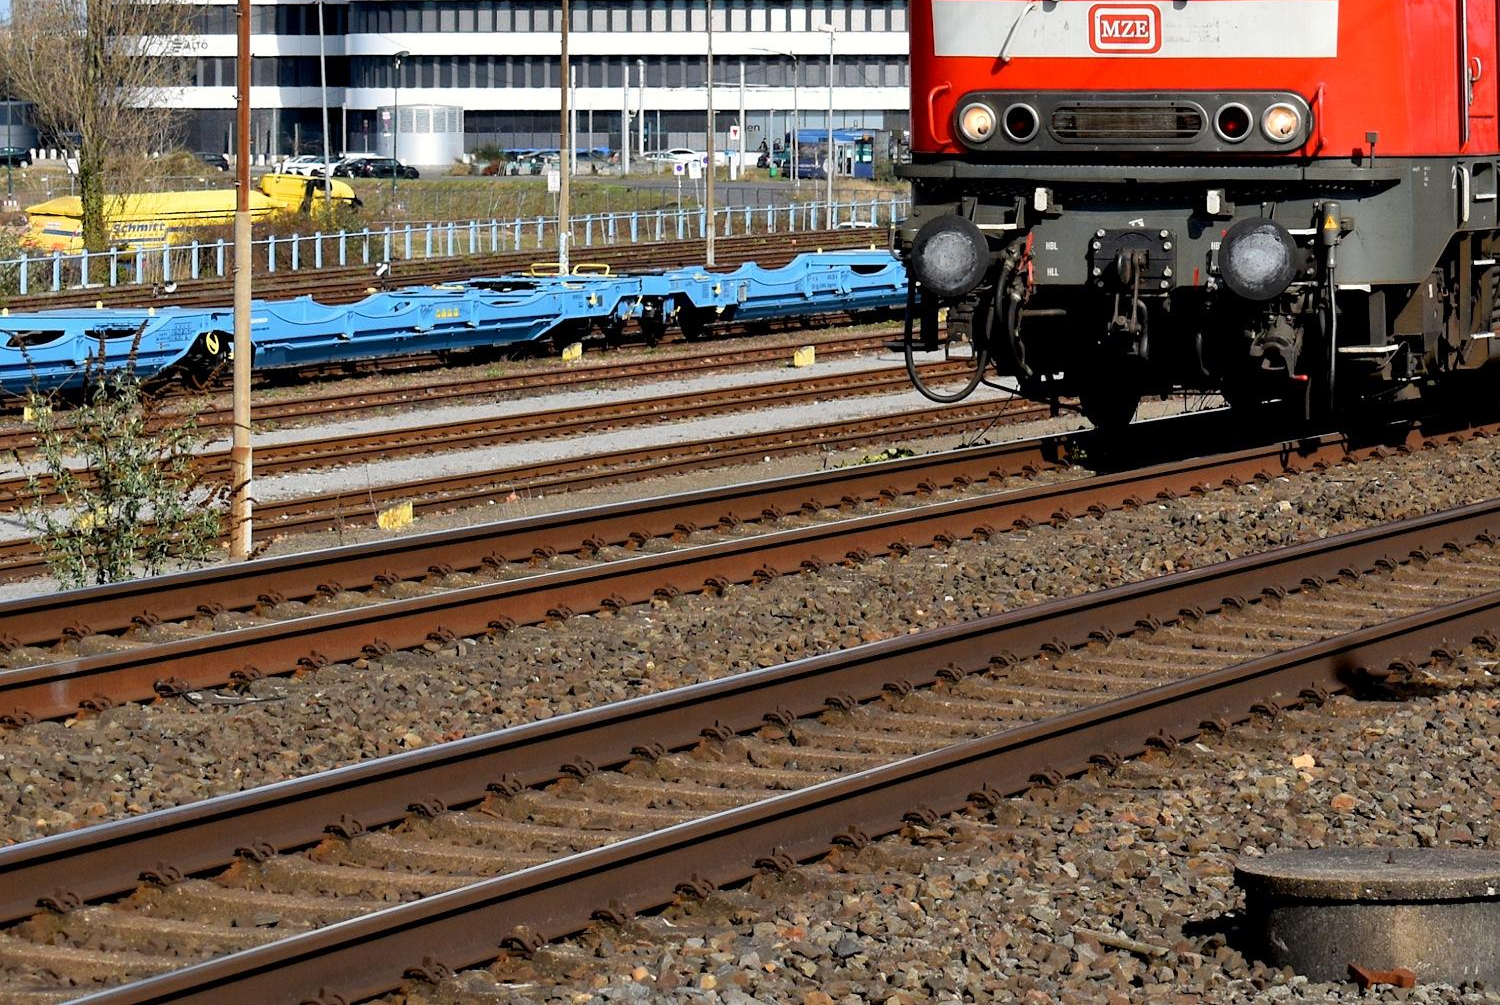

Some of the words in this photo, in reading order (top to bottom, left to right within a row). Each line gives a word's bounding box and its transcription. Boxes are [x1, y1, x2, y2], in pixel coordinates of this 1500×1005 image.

[1101, 20, 1149, 38] MZE
[1451, 165, 1457, 189] 2
[112, 222, 166, 234] Schmitt
[1045, 242, 1058, 250] HBL
[1211, 242, 1221, 250] HB
[1046, 268, 1059, 276] HLL
